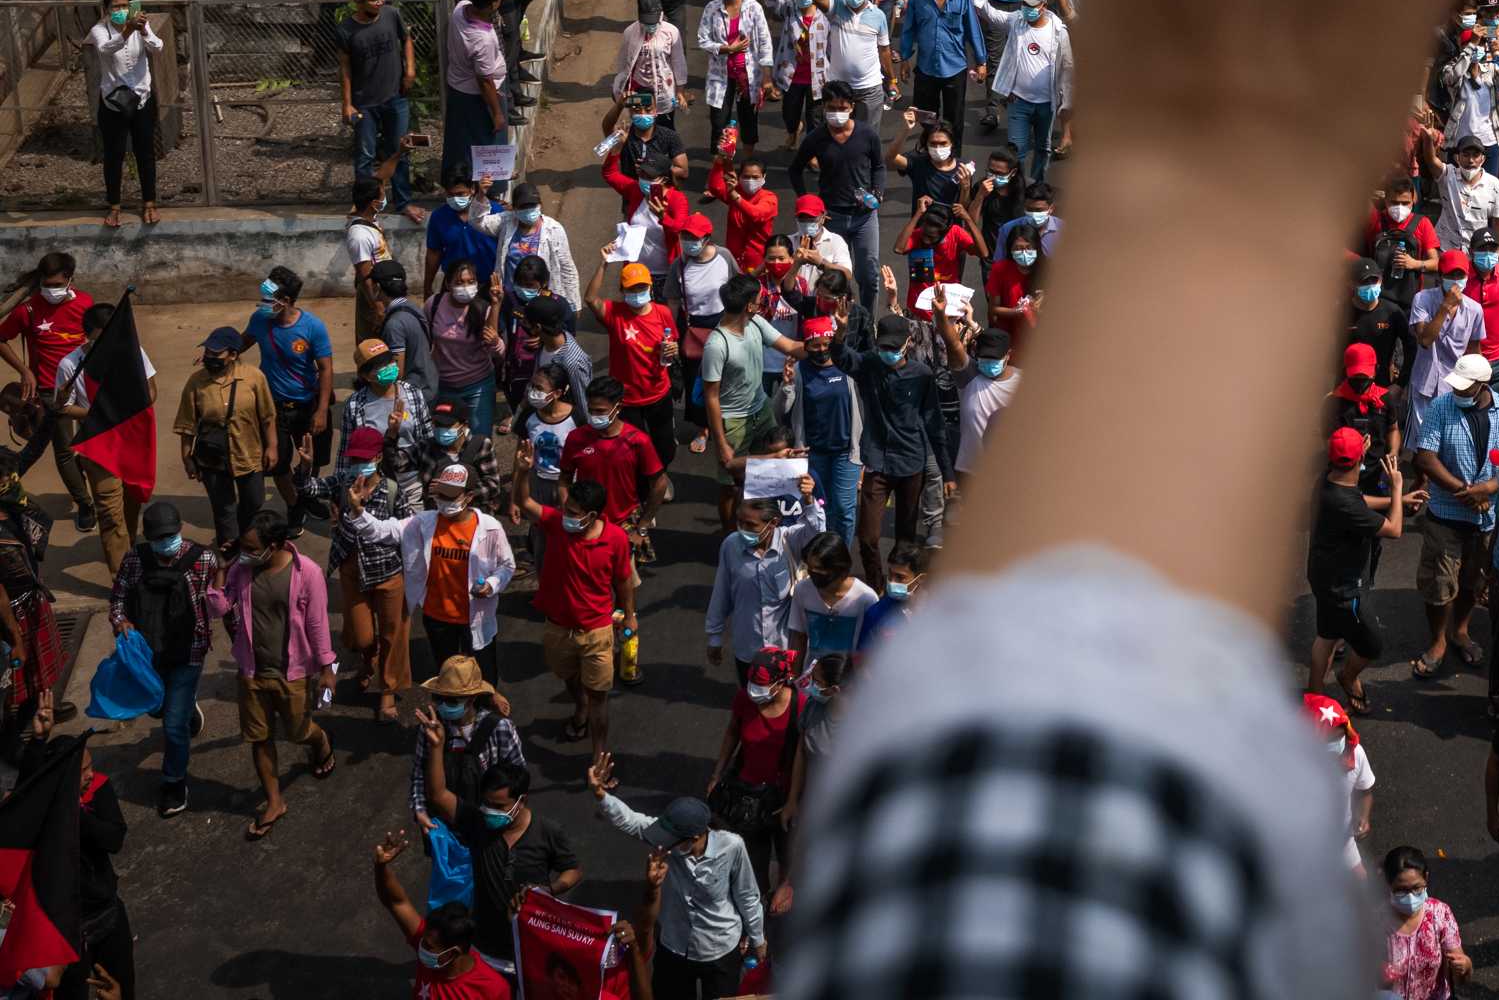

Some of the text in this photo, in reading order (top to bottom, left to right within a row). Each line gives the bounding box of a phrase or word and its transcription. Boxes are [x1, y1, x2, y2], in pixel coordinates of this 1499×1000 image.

[528, 917, 596, 945] AUNG SAN SUU KYI
